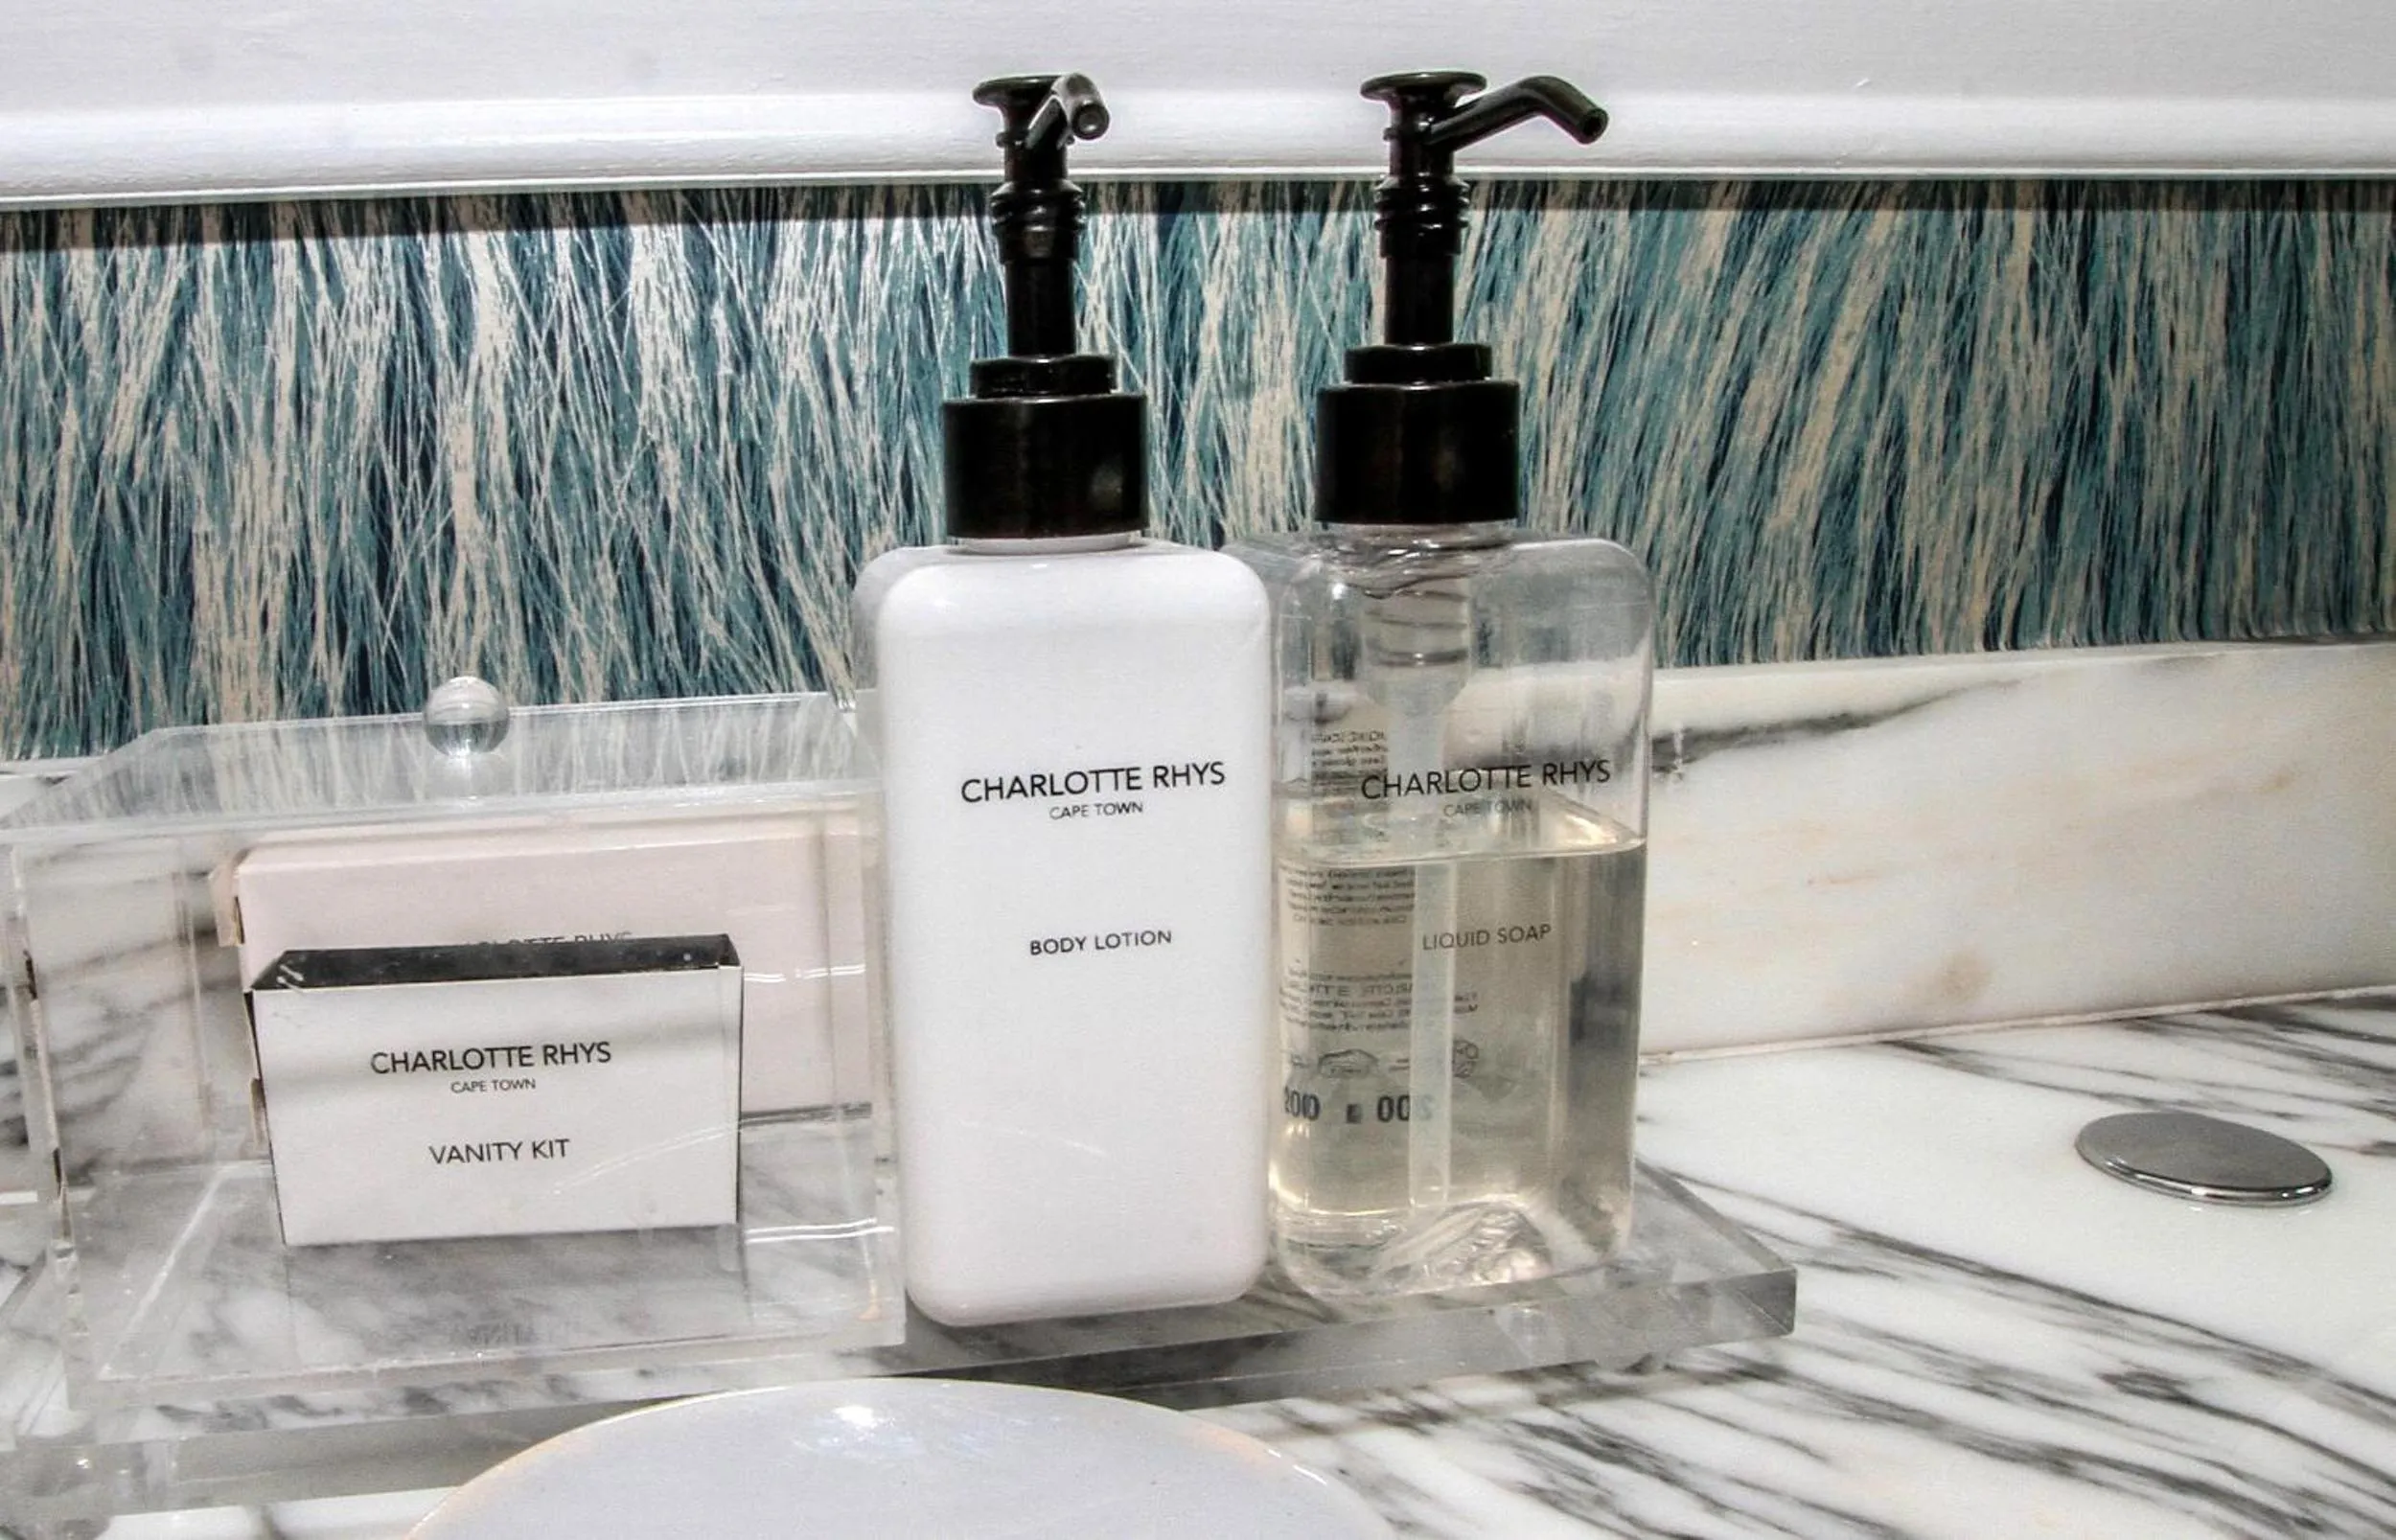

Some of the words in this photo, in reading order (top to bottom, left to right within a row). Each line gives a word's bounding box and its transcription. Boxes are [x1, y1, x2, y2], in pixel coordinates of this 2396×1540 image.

[961, 767, 1142, 803] CHARLOTTE
[1153, 762, 1226, 788] RHYS
[1361, 765, 1532, 799] CHARLOTTE
[1542, 760, 1611, 786] RHYS
[1049, 804, 1089, 819] CAPE
[1094, 801, 1143, 816] TOWN
[1444, 801, 1481, 816] CAPE
[1486, 798, 1532, 814] TOWN
[1030, 936, 1086, 955] BODY
[1094, 931, 1172, 950] LOTION
[1422, 930, 1489, 951] LIQUID
[1497, 924, 1552, 944] SOAP
[370, 1046, 535, 1074] CHARLOTTE
[542, 1042, 611, 1066] RHYS
[451, 1080, 487, 1093] CAPE
[493, 1078, 536, 1092] TOWN
[429, 1140, 523, 1164] VANITY
[533, 1138, 569, 1159] KIT
